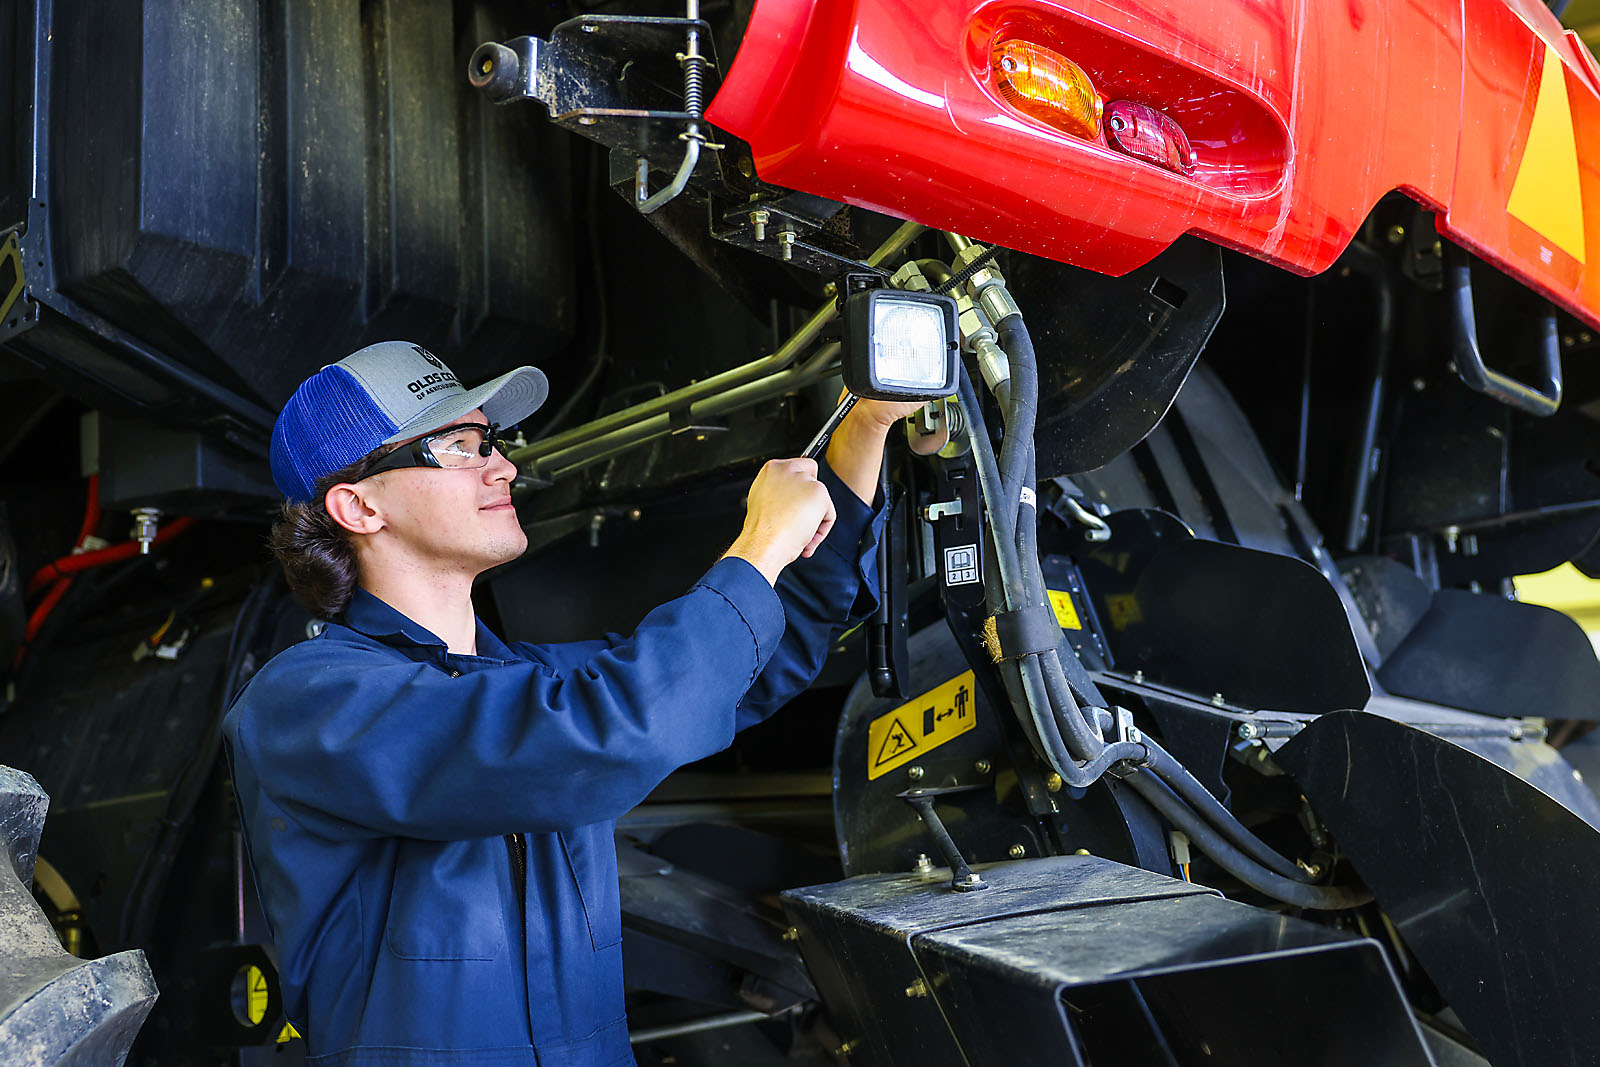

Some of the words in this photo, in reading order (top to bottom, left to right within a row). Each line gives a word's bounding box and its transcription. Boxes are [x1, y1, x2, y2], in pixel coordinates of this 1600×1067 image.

[407, 372, 442, 393] OLDS
[440, 372, 456, 381] CO
[416, 391, 426, 400] OF
